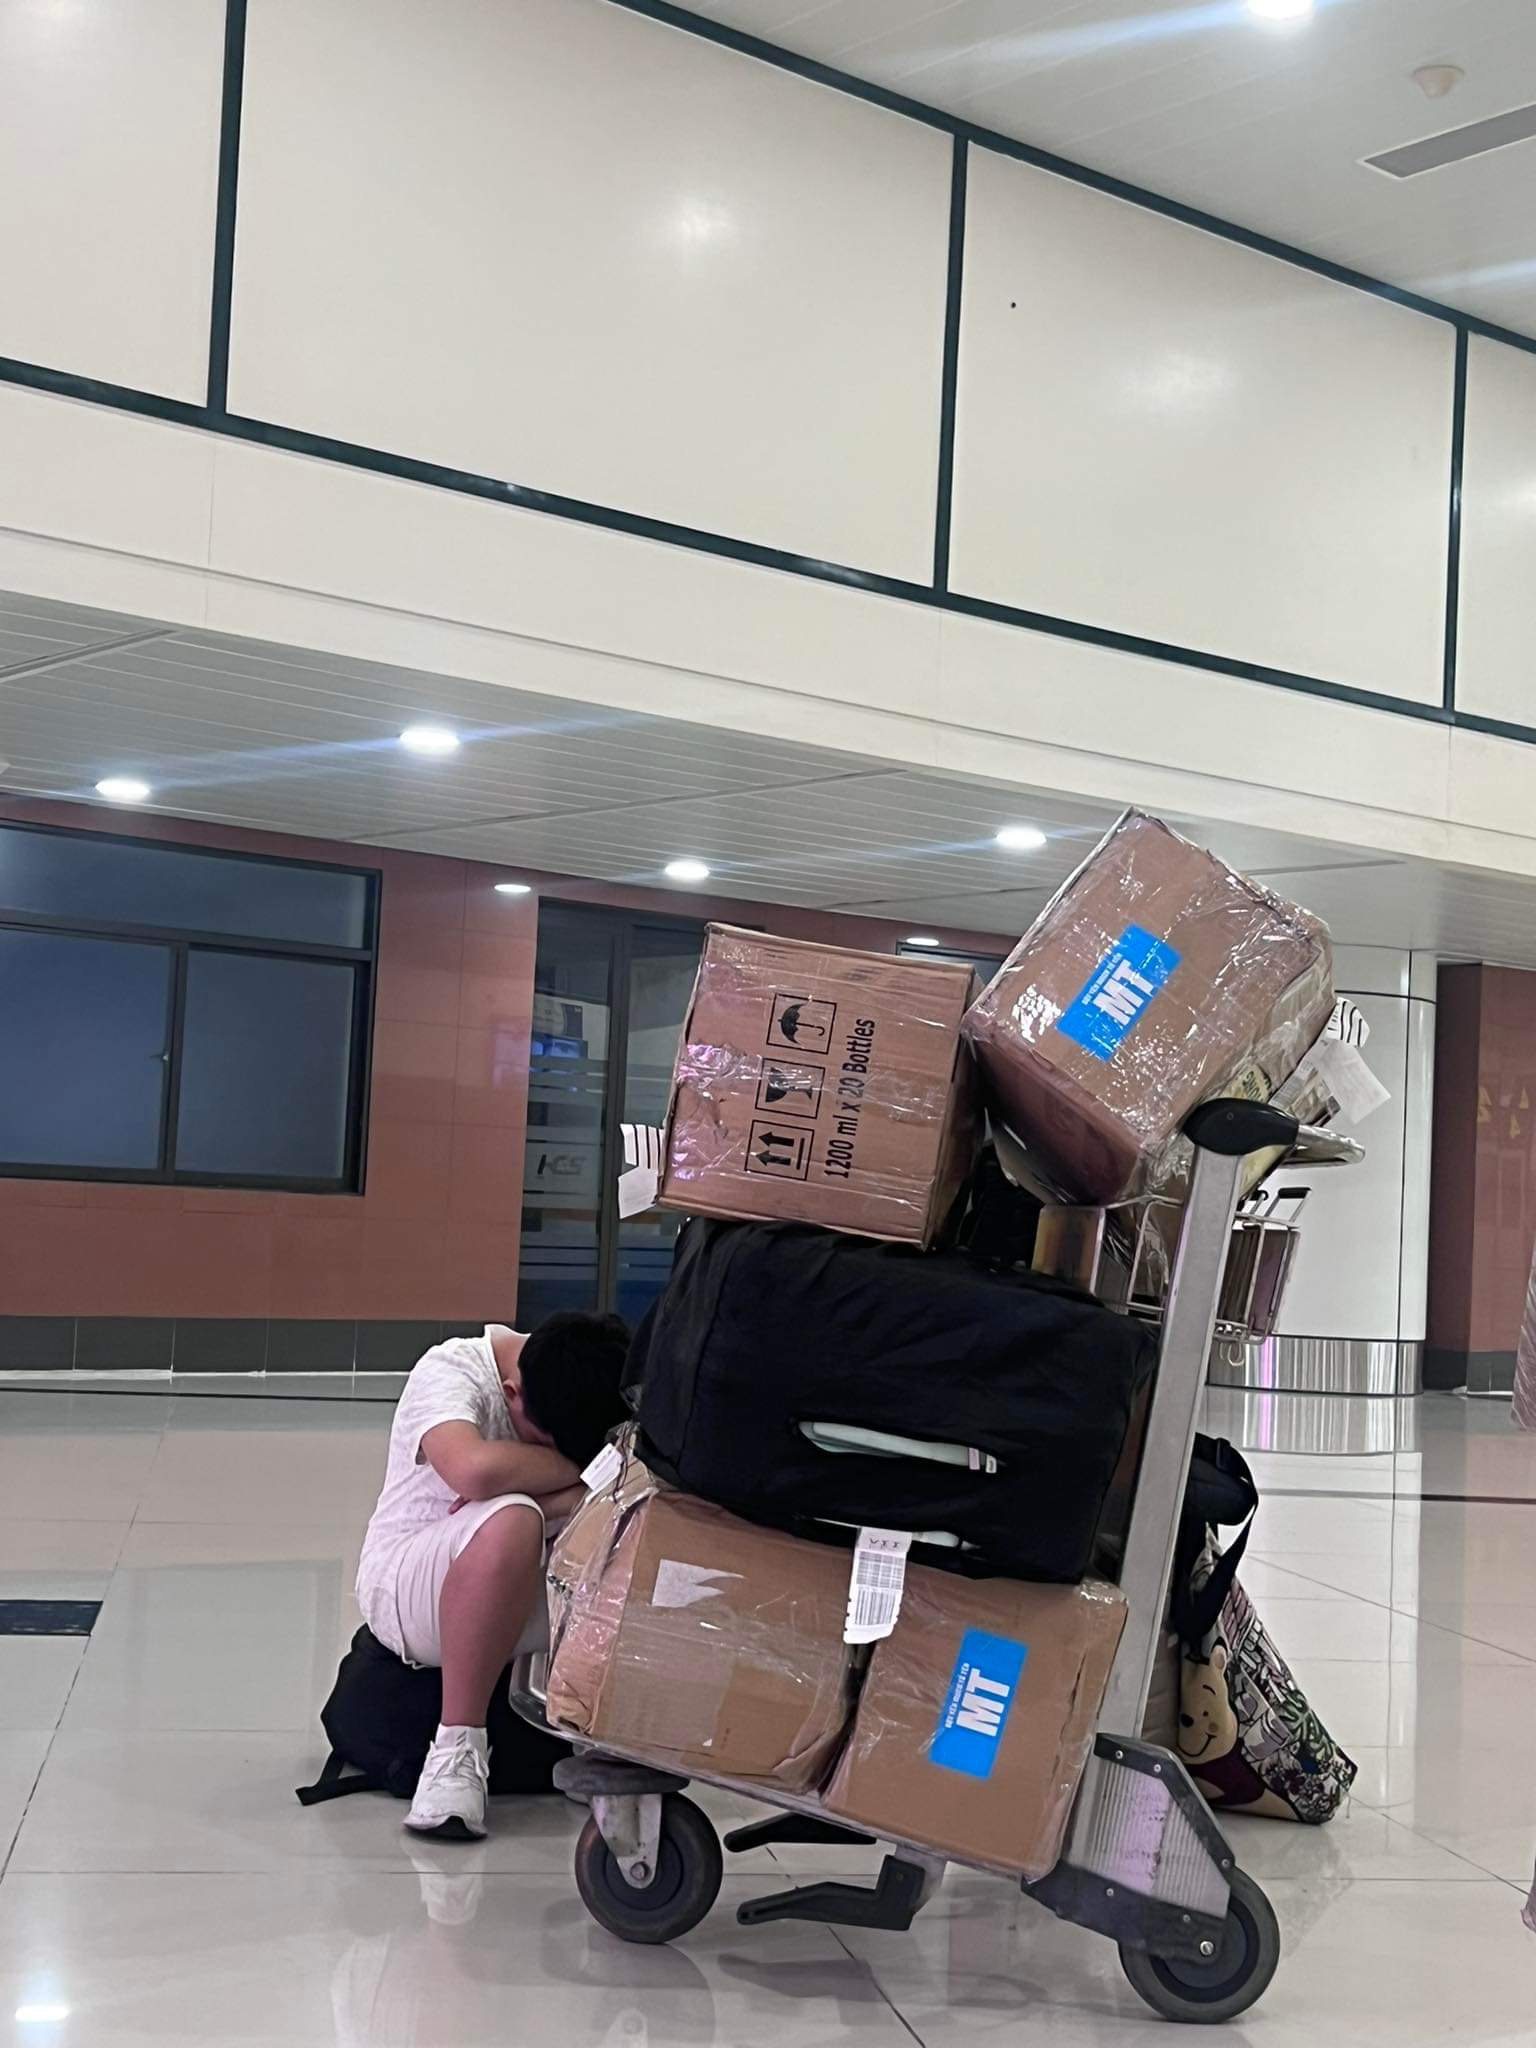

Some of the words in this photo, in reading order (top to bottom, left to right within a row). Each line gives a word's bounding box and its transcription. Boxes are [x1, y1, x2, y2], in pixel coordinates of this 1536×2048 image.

[1093, 959, 1155, 1026] MT
[842, 1018, 876, 1074] Bottles
[838, 1077, 865, 1098] 20
[841, 1102, 861, 1112] x
[833, 1115, 859, 1136] ml
[824, 1139, 855, 1179] 1200
[956, 1667, 1010, 1737] MT
